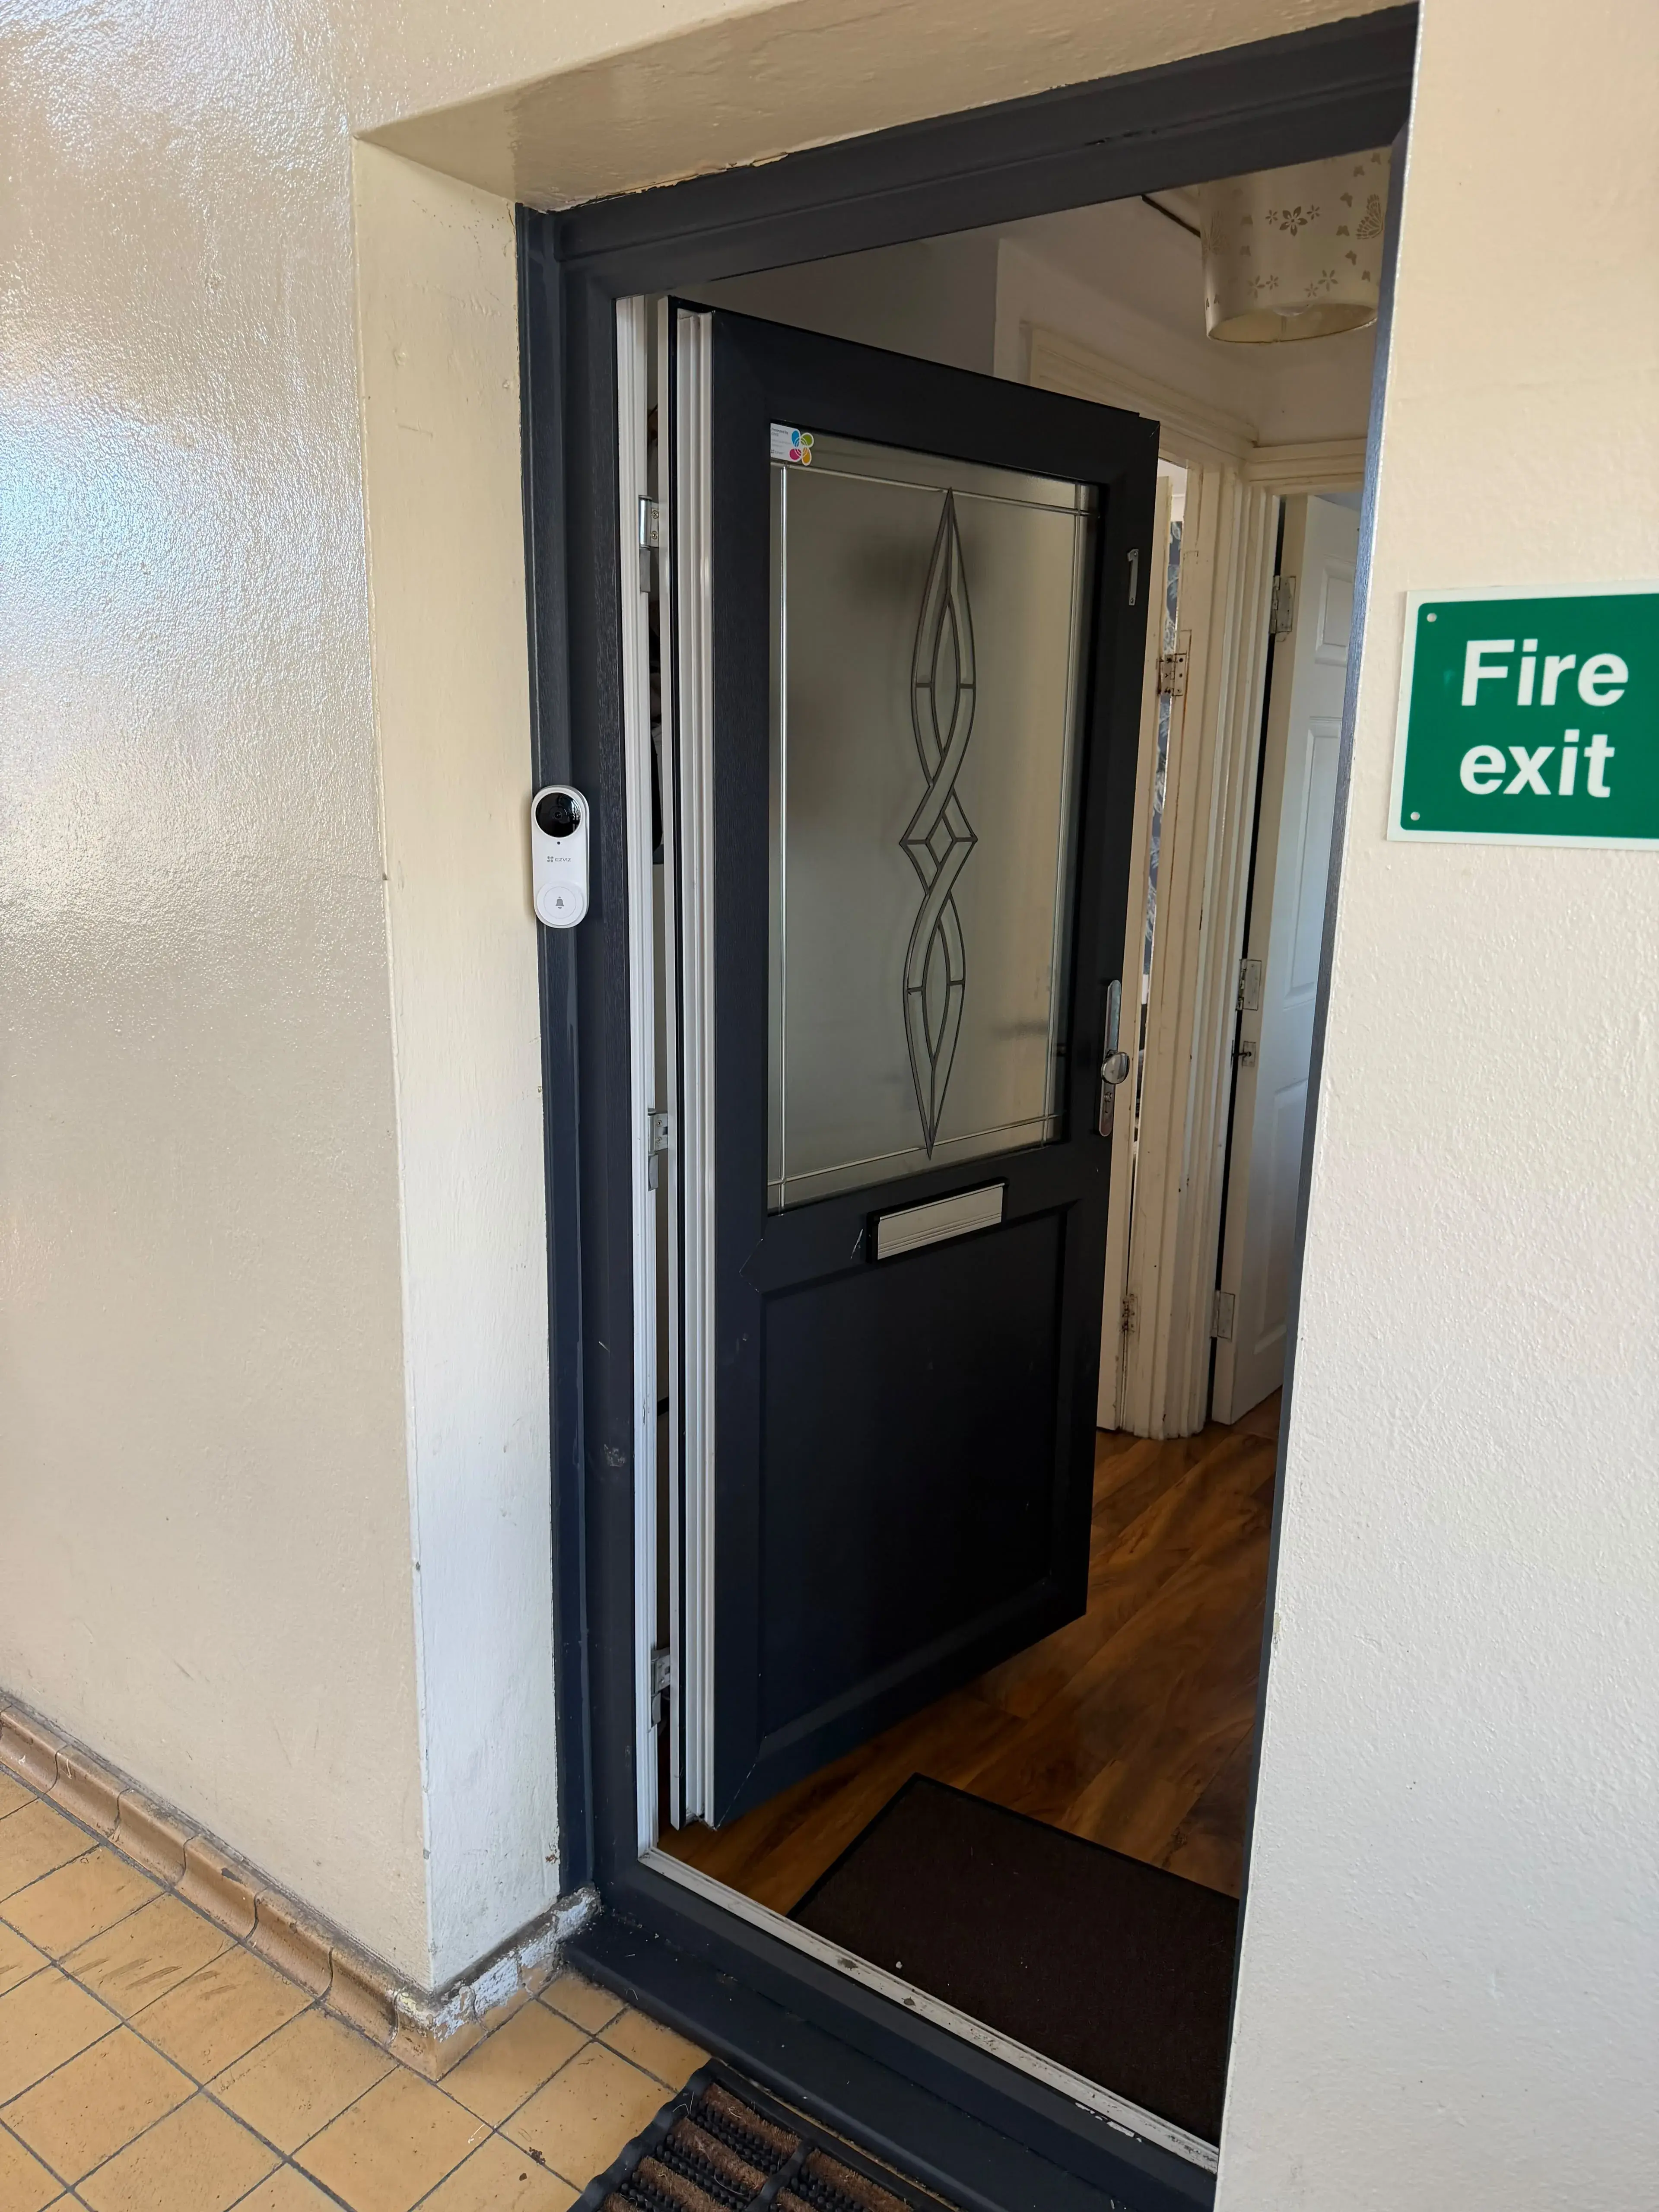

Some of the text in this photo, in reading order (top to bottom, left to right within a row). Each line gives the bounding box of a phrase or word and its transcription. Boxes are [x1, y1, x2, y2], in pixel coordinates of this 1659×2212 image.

[1127, 549, 1139, 606] 1
[1462, 639, 1629, 706] Fire
[1460, 729, 1615, 798] exit
